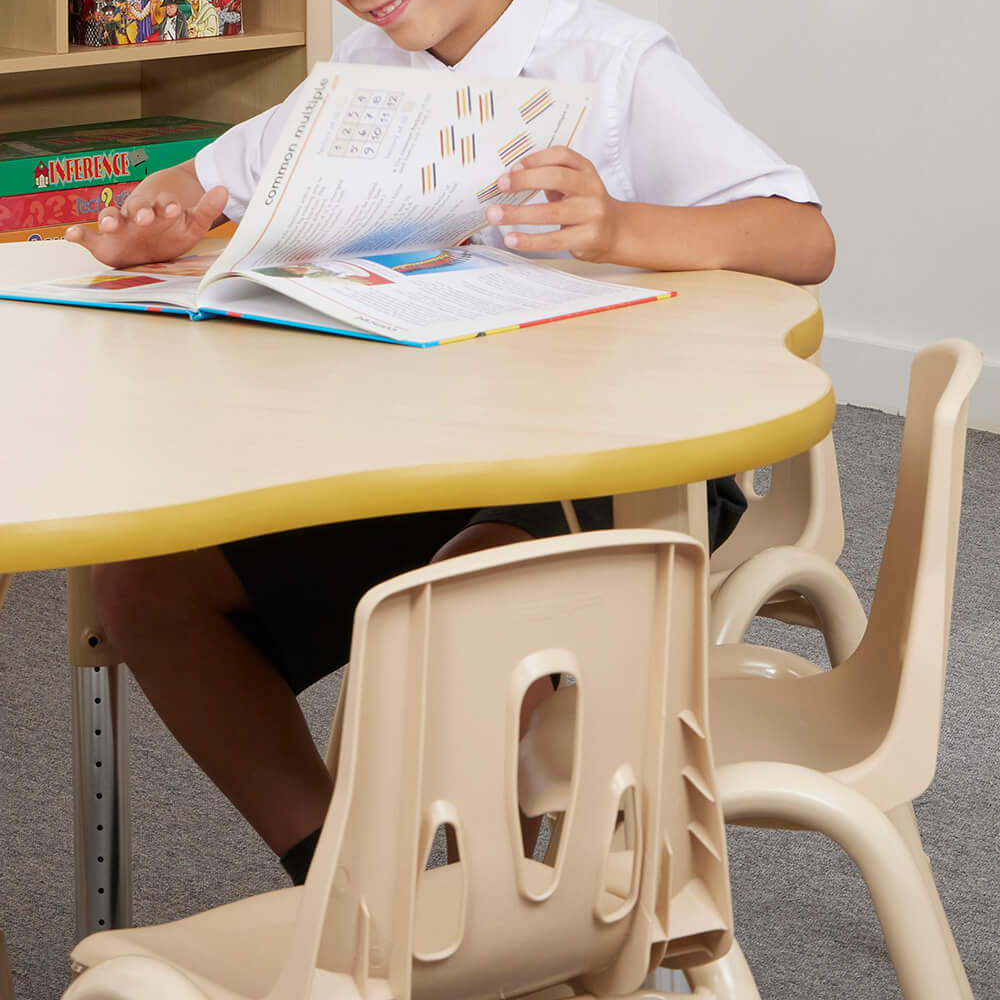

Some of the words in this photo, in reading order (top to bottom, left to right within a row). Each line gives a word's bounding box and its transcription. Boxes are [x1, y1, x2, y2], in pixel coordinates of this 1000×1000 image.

[48, 152, 130, 186] INFERENCE
[265, 143, 297, 206] common
[295, 78, 328, 139] multiple
